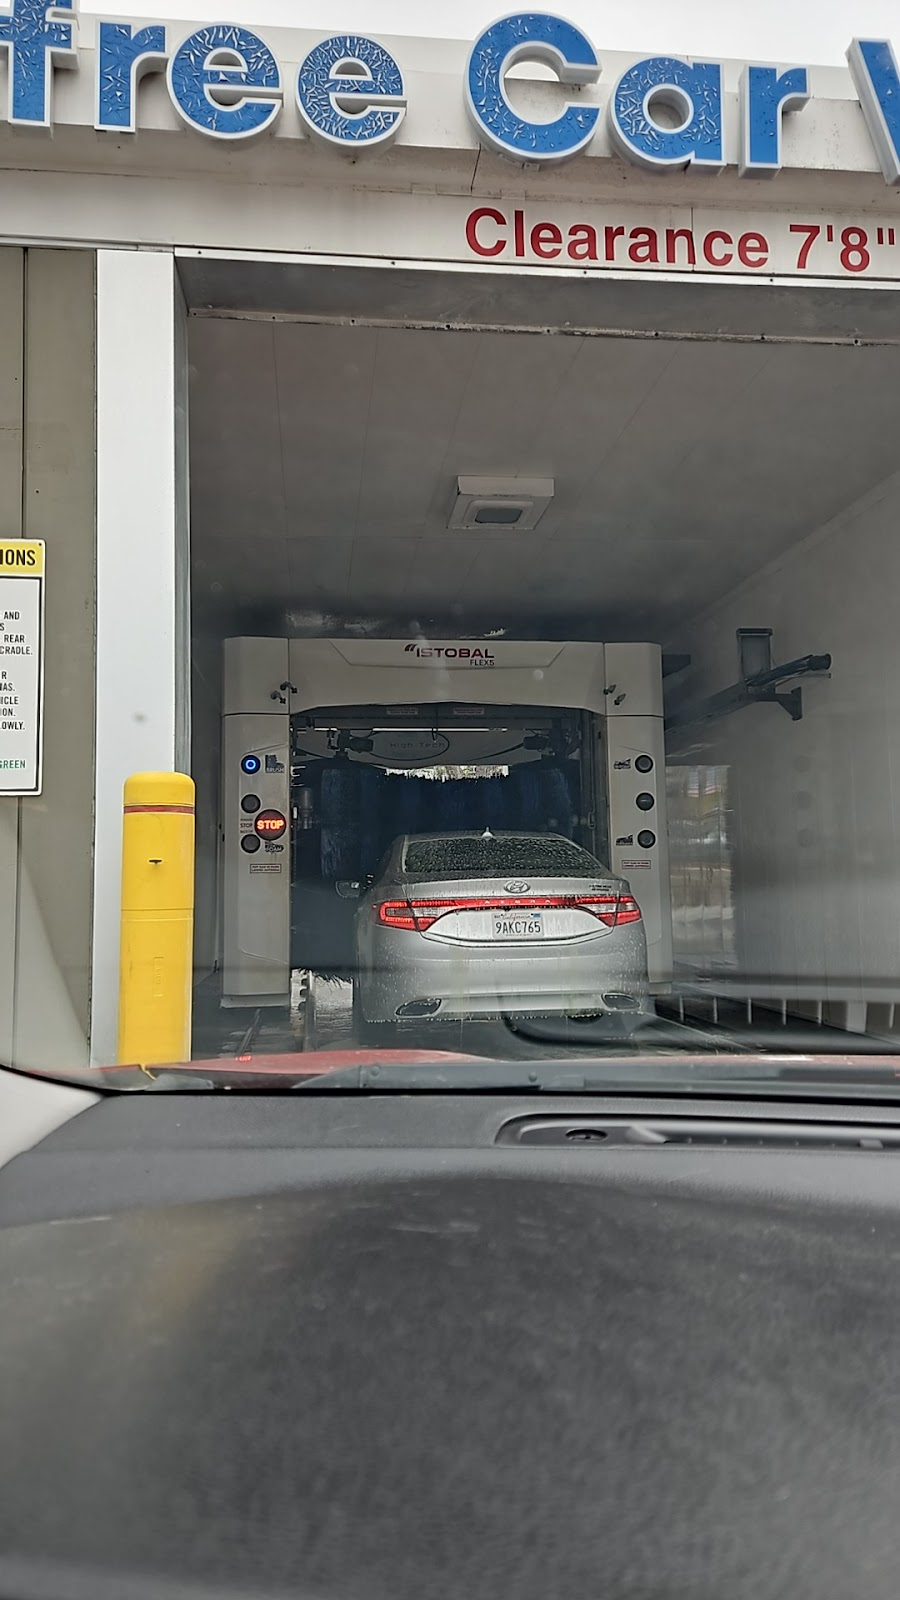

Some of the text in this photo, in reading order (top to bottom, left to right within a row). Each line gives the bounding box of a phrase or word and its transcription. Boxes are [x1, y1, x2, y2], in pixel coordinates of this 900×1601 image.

[464, 10, 811, 174] Car
[464, 206, 896, 273] Clearance 7'8"
[3, 610, 20, 621] AND
[3, 634, 25, 644] REAR
[416, 647, 495, 658] ISTOBAL
[0, 720, 26, 731] OWLY.
[256, 819, 284, 830] STOP
[495, 920, 541, 934] 9AKC765
